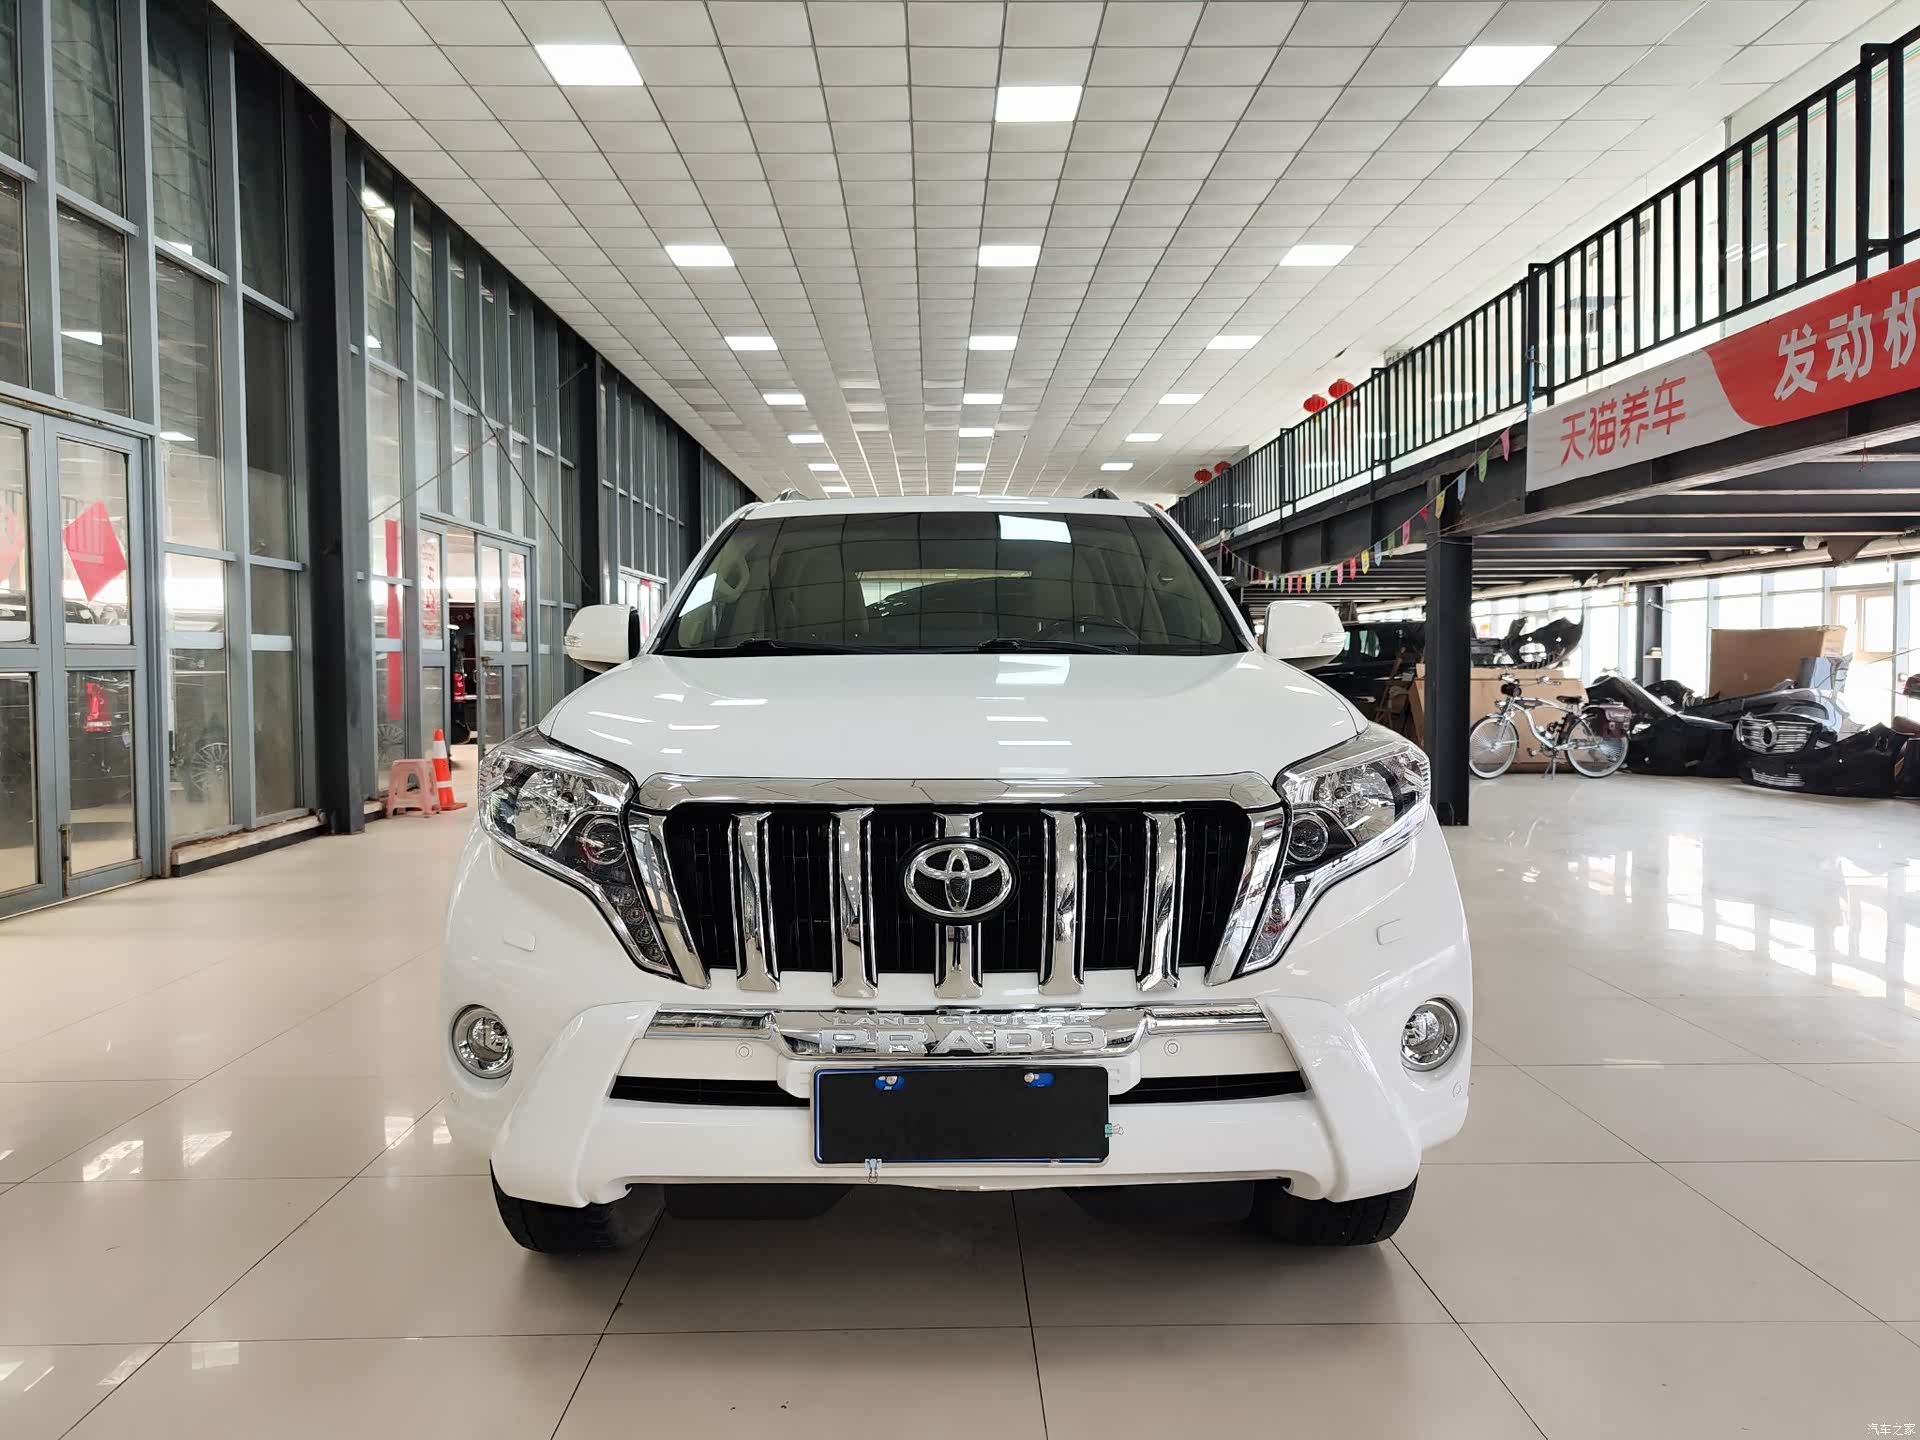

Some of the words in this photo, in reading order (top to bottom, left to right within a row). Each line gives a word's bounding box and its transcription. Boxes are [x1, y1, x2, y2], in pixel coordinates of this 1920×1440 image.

[1560, 376, 1686, 465] 天猫养车
[832, 1015, 925, 1026] LAND
[936, 1013, 1090, 1025] CRUISER
[818, 1027, 1107, 1054] PRADO
